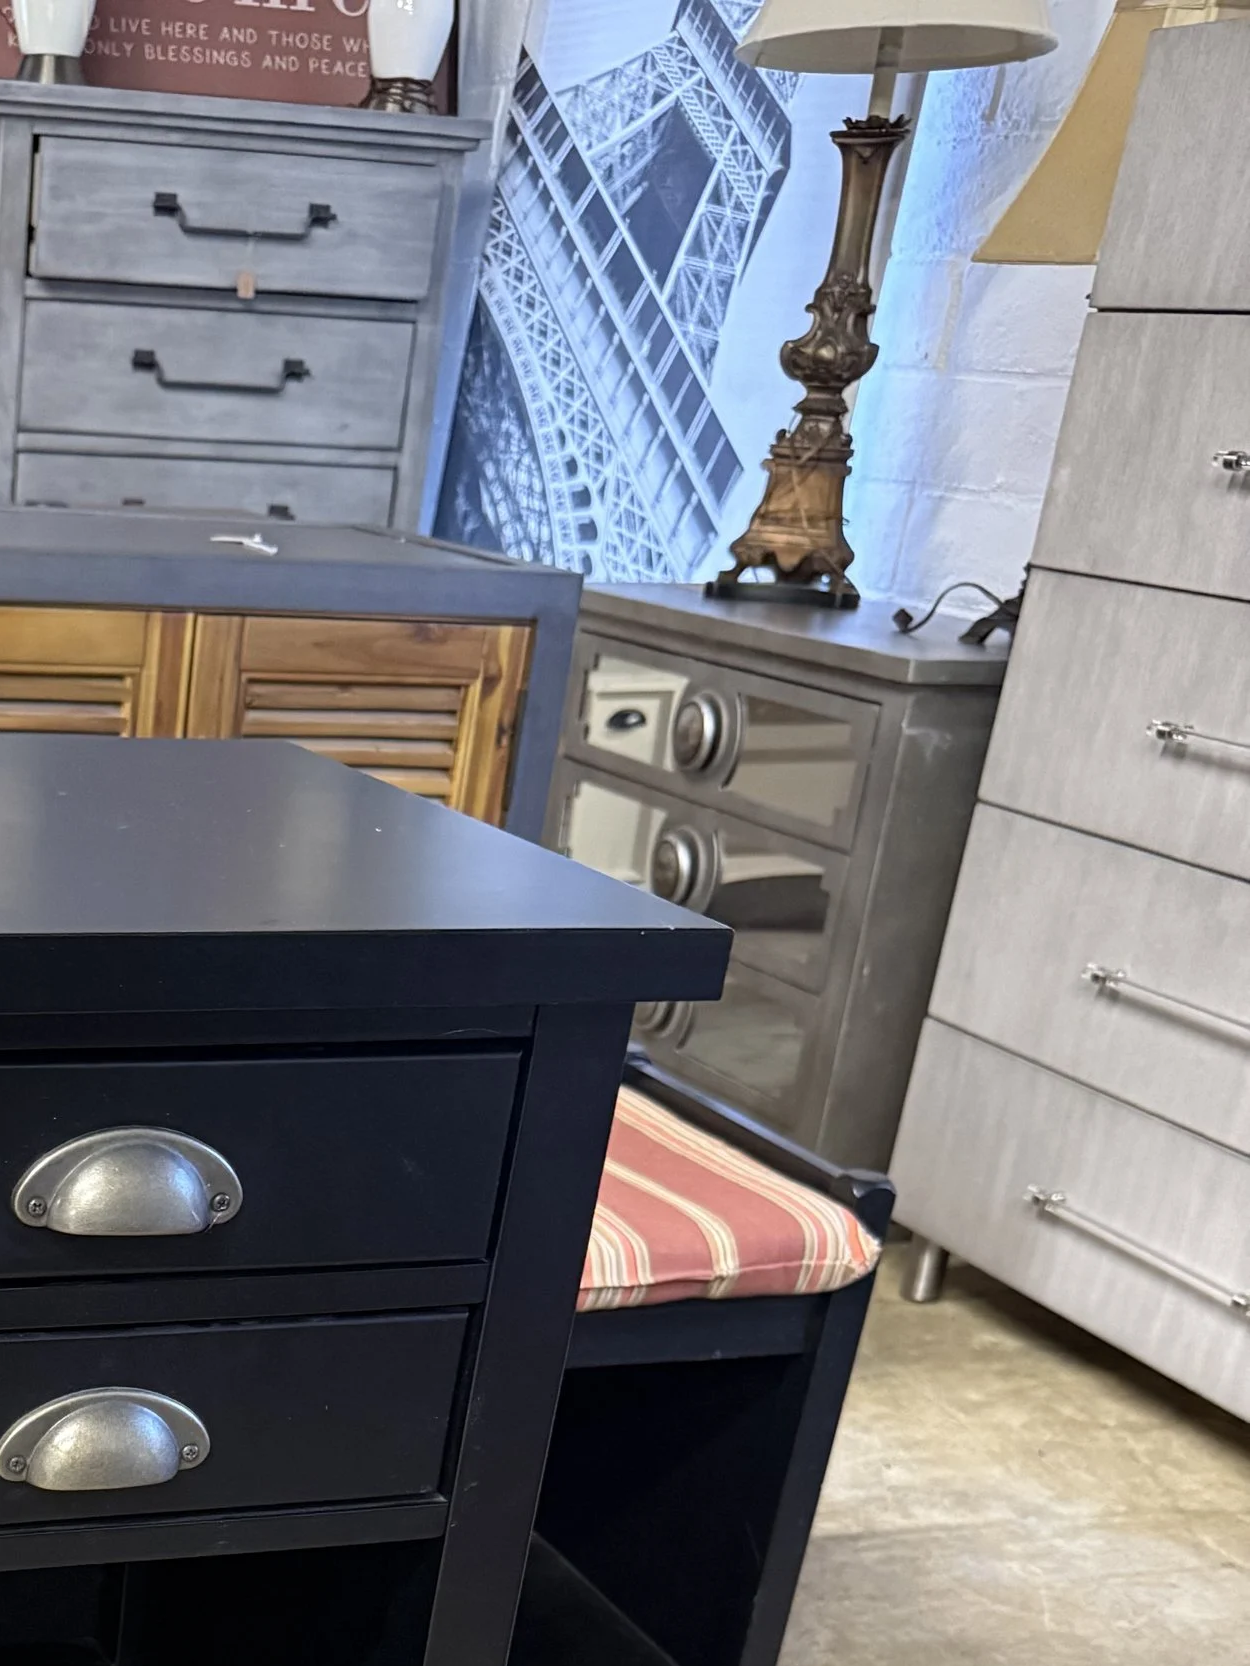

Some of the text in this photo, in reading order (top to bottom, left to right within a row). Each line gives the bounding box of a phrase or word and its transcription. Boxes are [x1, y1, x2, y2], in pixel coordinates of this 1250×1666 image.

[109, 17, 151, 35] LIVE
[161, 21, 209, 41] HERE
[218, 26, 258, 45] AND
[268, 30, 333, 52] THOSE
[342, 36, 370, 55] WH
[84, 39, 135, 58] ONLY
[144, 43, 252, 68] BLESSINGS
[261, 54, 300, 73] AND
[308, 58, 368, 78] PEACE
